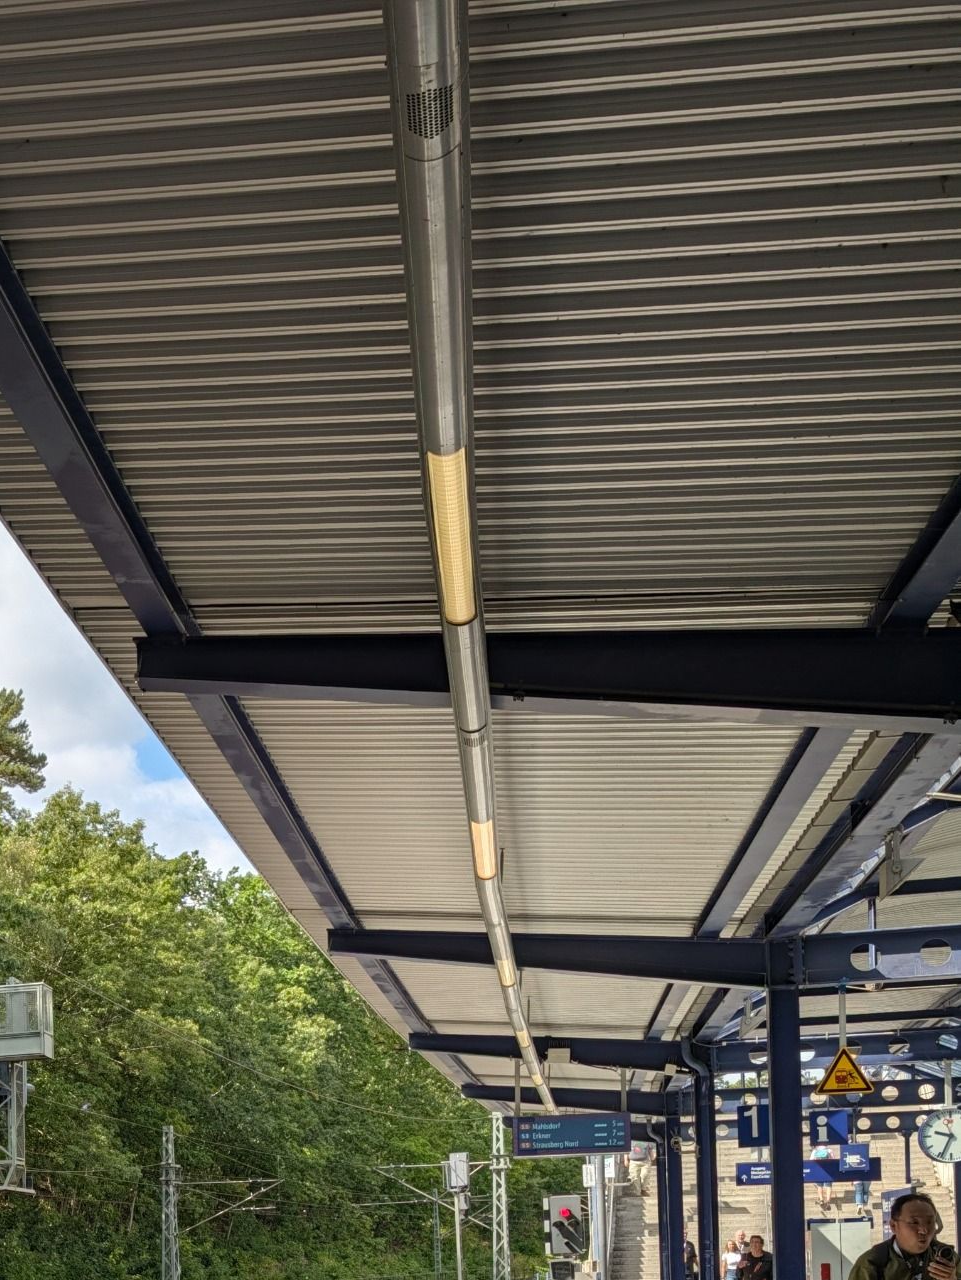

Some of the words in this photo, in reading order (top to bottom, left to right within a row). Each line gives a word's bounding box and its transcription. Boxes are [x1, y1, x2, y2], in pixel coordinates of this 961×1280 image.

[532, 1122, 561, 1130] Mahlsdorf
[743, 1105, 759, 1138] 1
[816, 1115, 830, 1142] i
[532, 1141, 564, 1149] Strausberg
